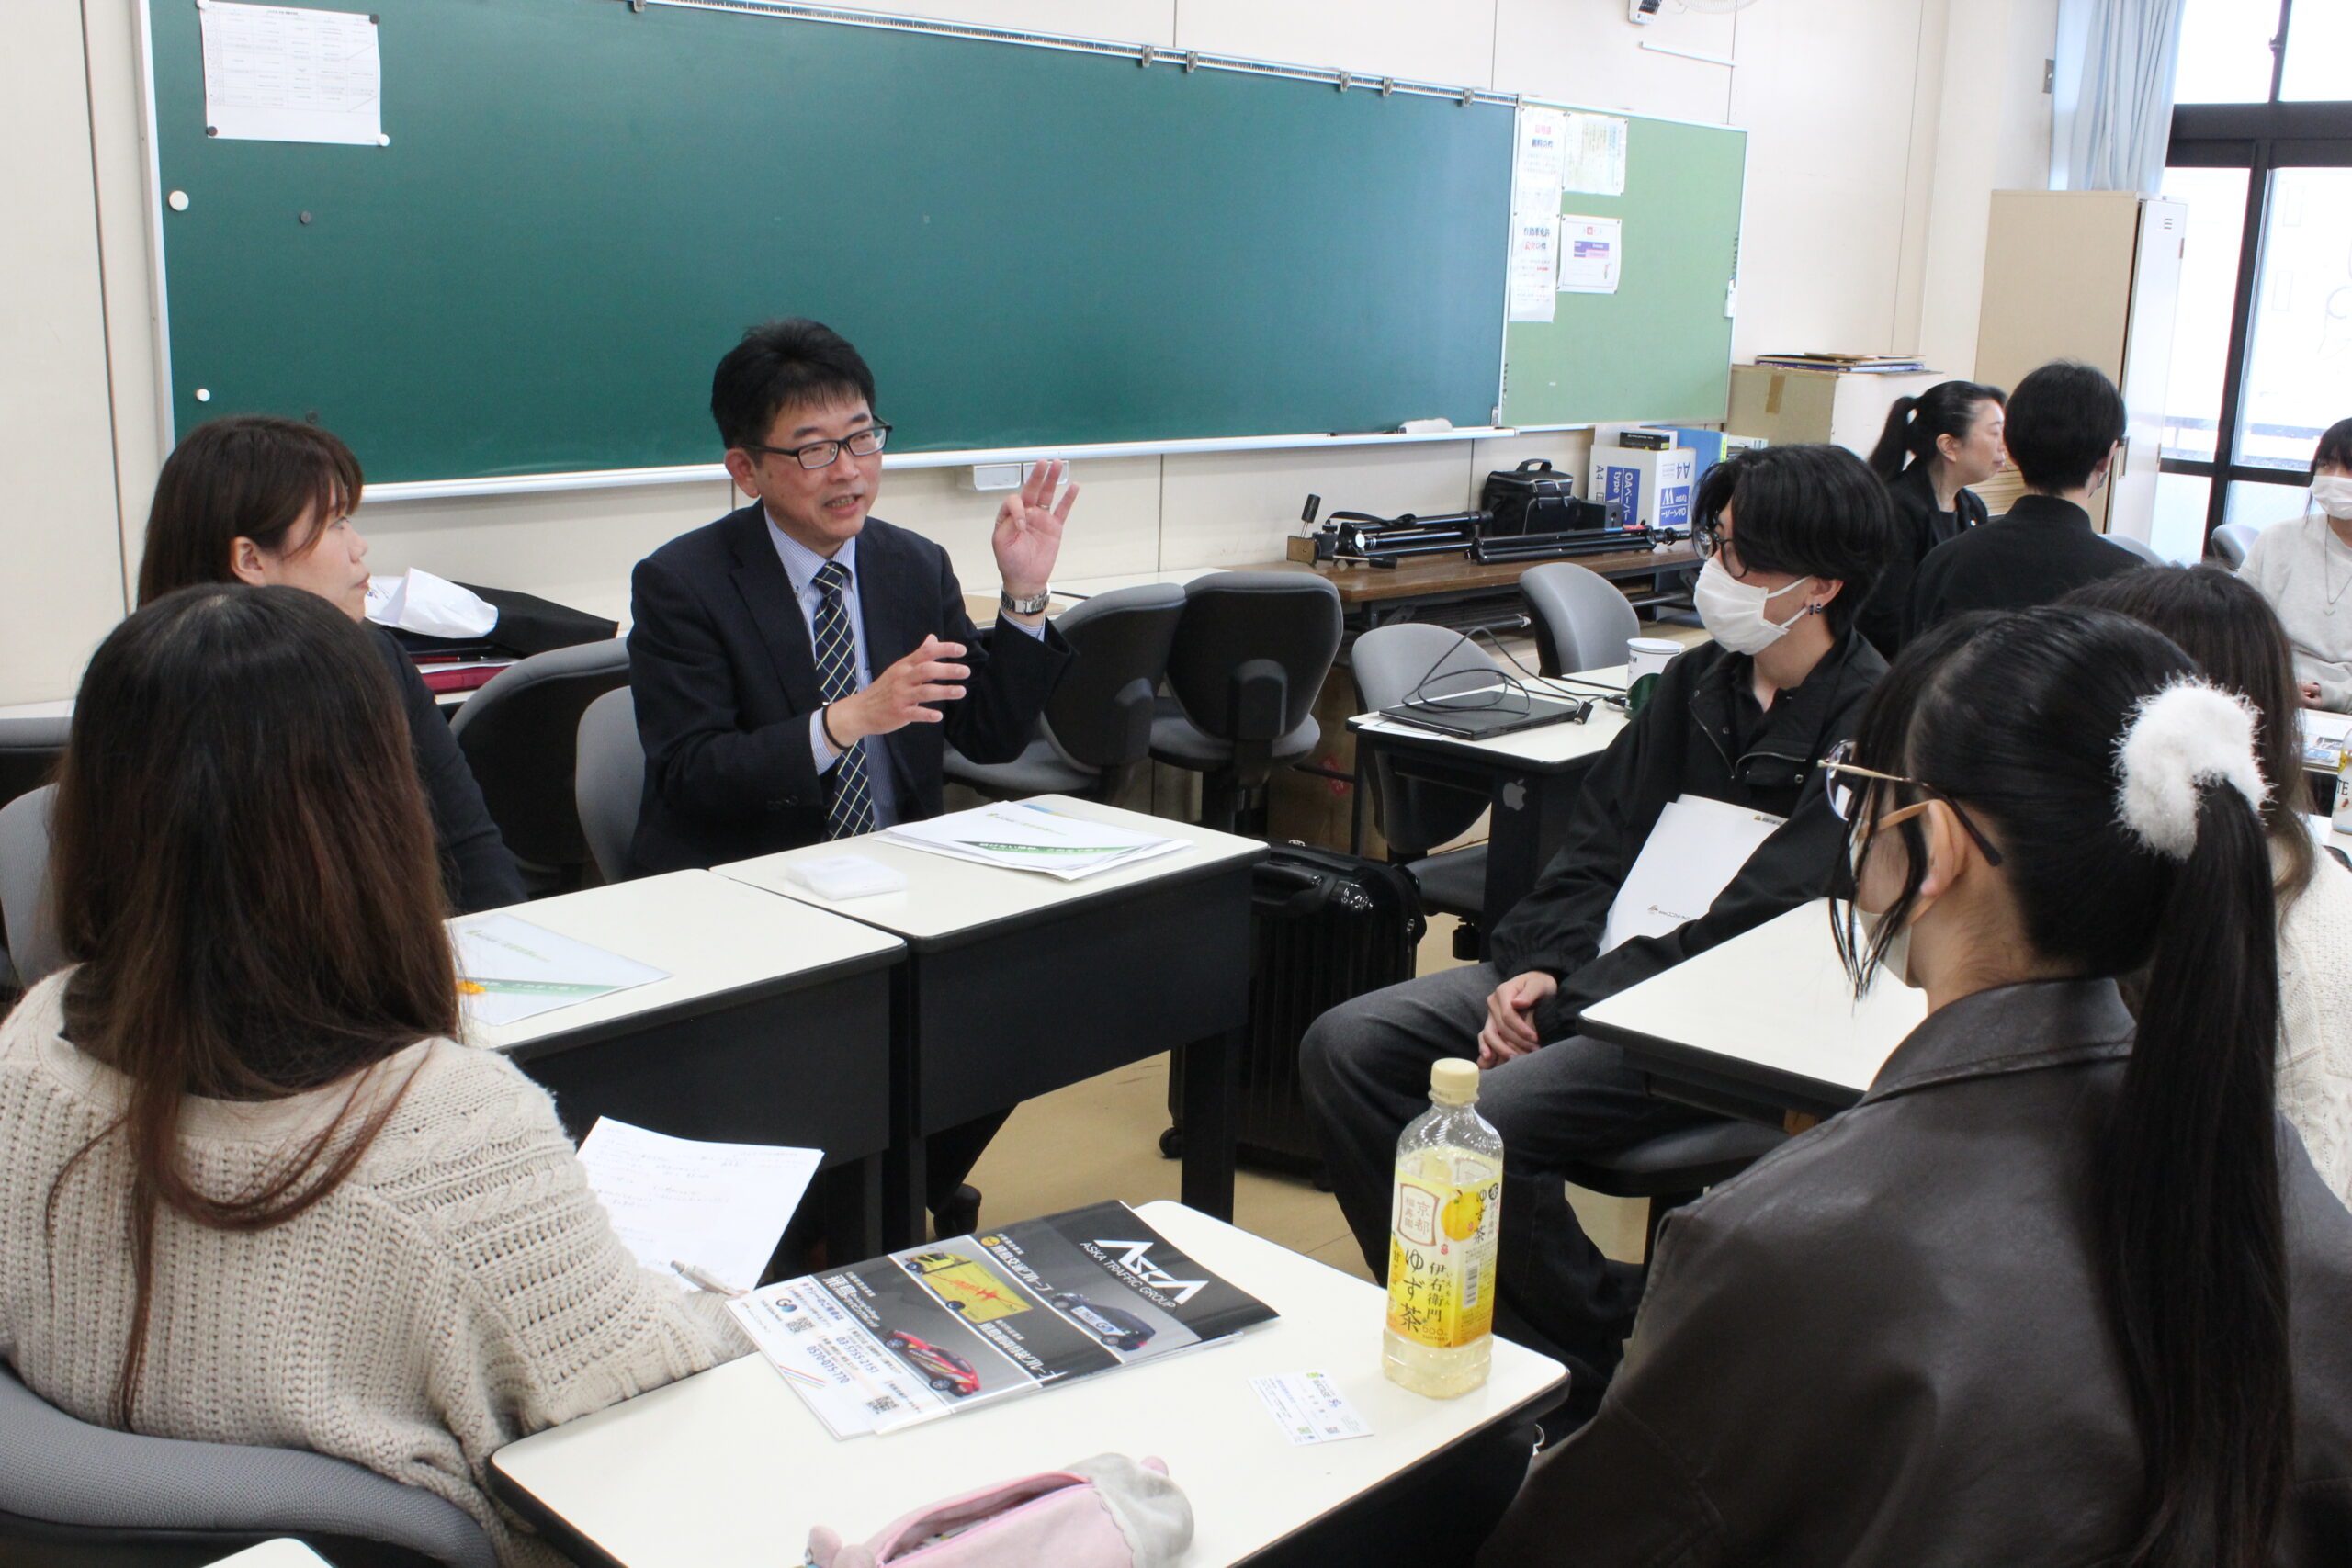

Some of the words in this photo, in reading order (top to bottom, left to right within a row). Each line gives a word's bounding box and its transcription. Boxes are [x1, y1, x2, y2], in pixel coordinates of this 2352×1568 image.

[1596, 465, 1604, 479] A4
[1613, 471, 1622, 493] type
[1676, 461, 1690, 479] A4
[1623, 472, 1633, 521] OAペーパー
[1415, 1201, 1430, 1235] 京都
[1080, 1242, 1107, 1262] ASKA
[1104, 1259, 1143, 1288] TRAFFIC
[1139, 1287, 1176, 1308] GROUP
[1399, 1247, 1425, 1333] ゆず茶
[1427, 1262, 1446, 1323] 伊右衛門
